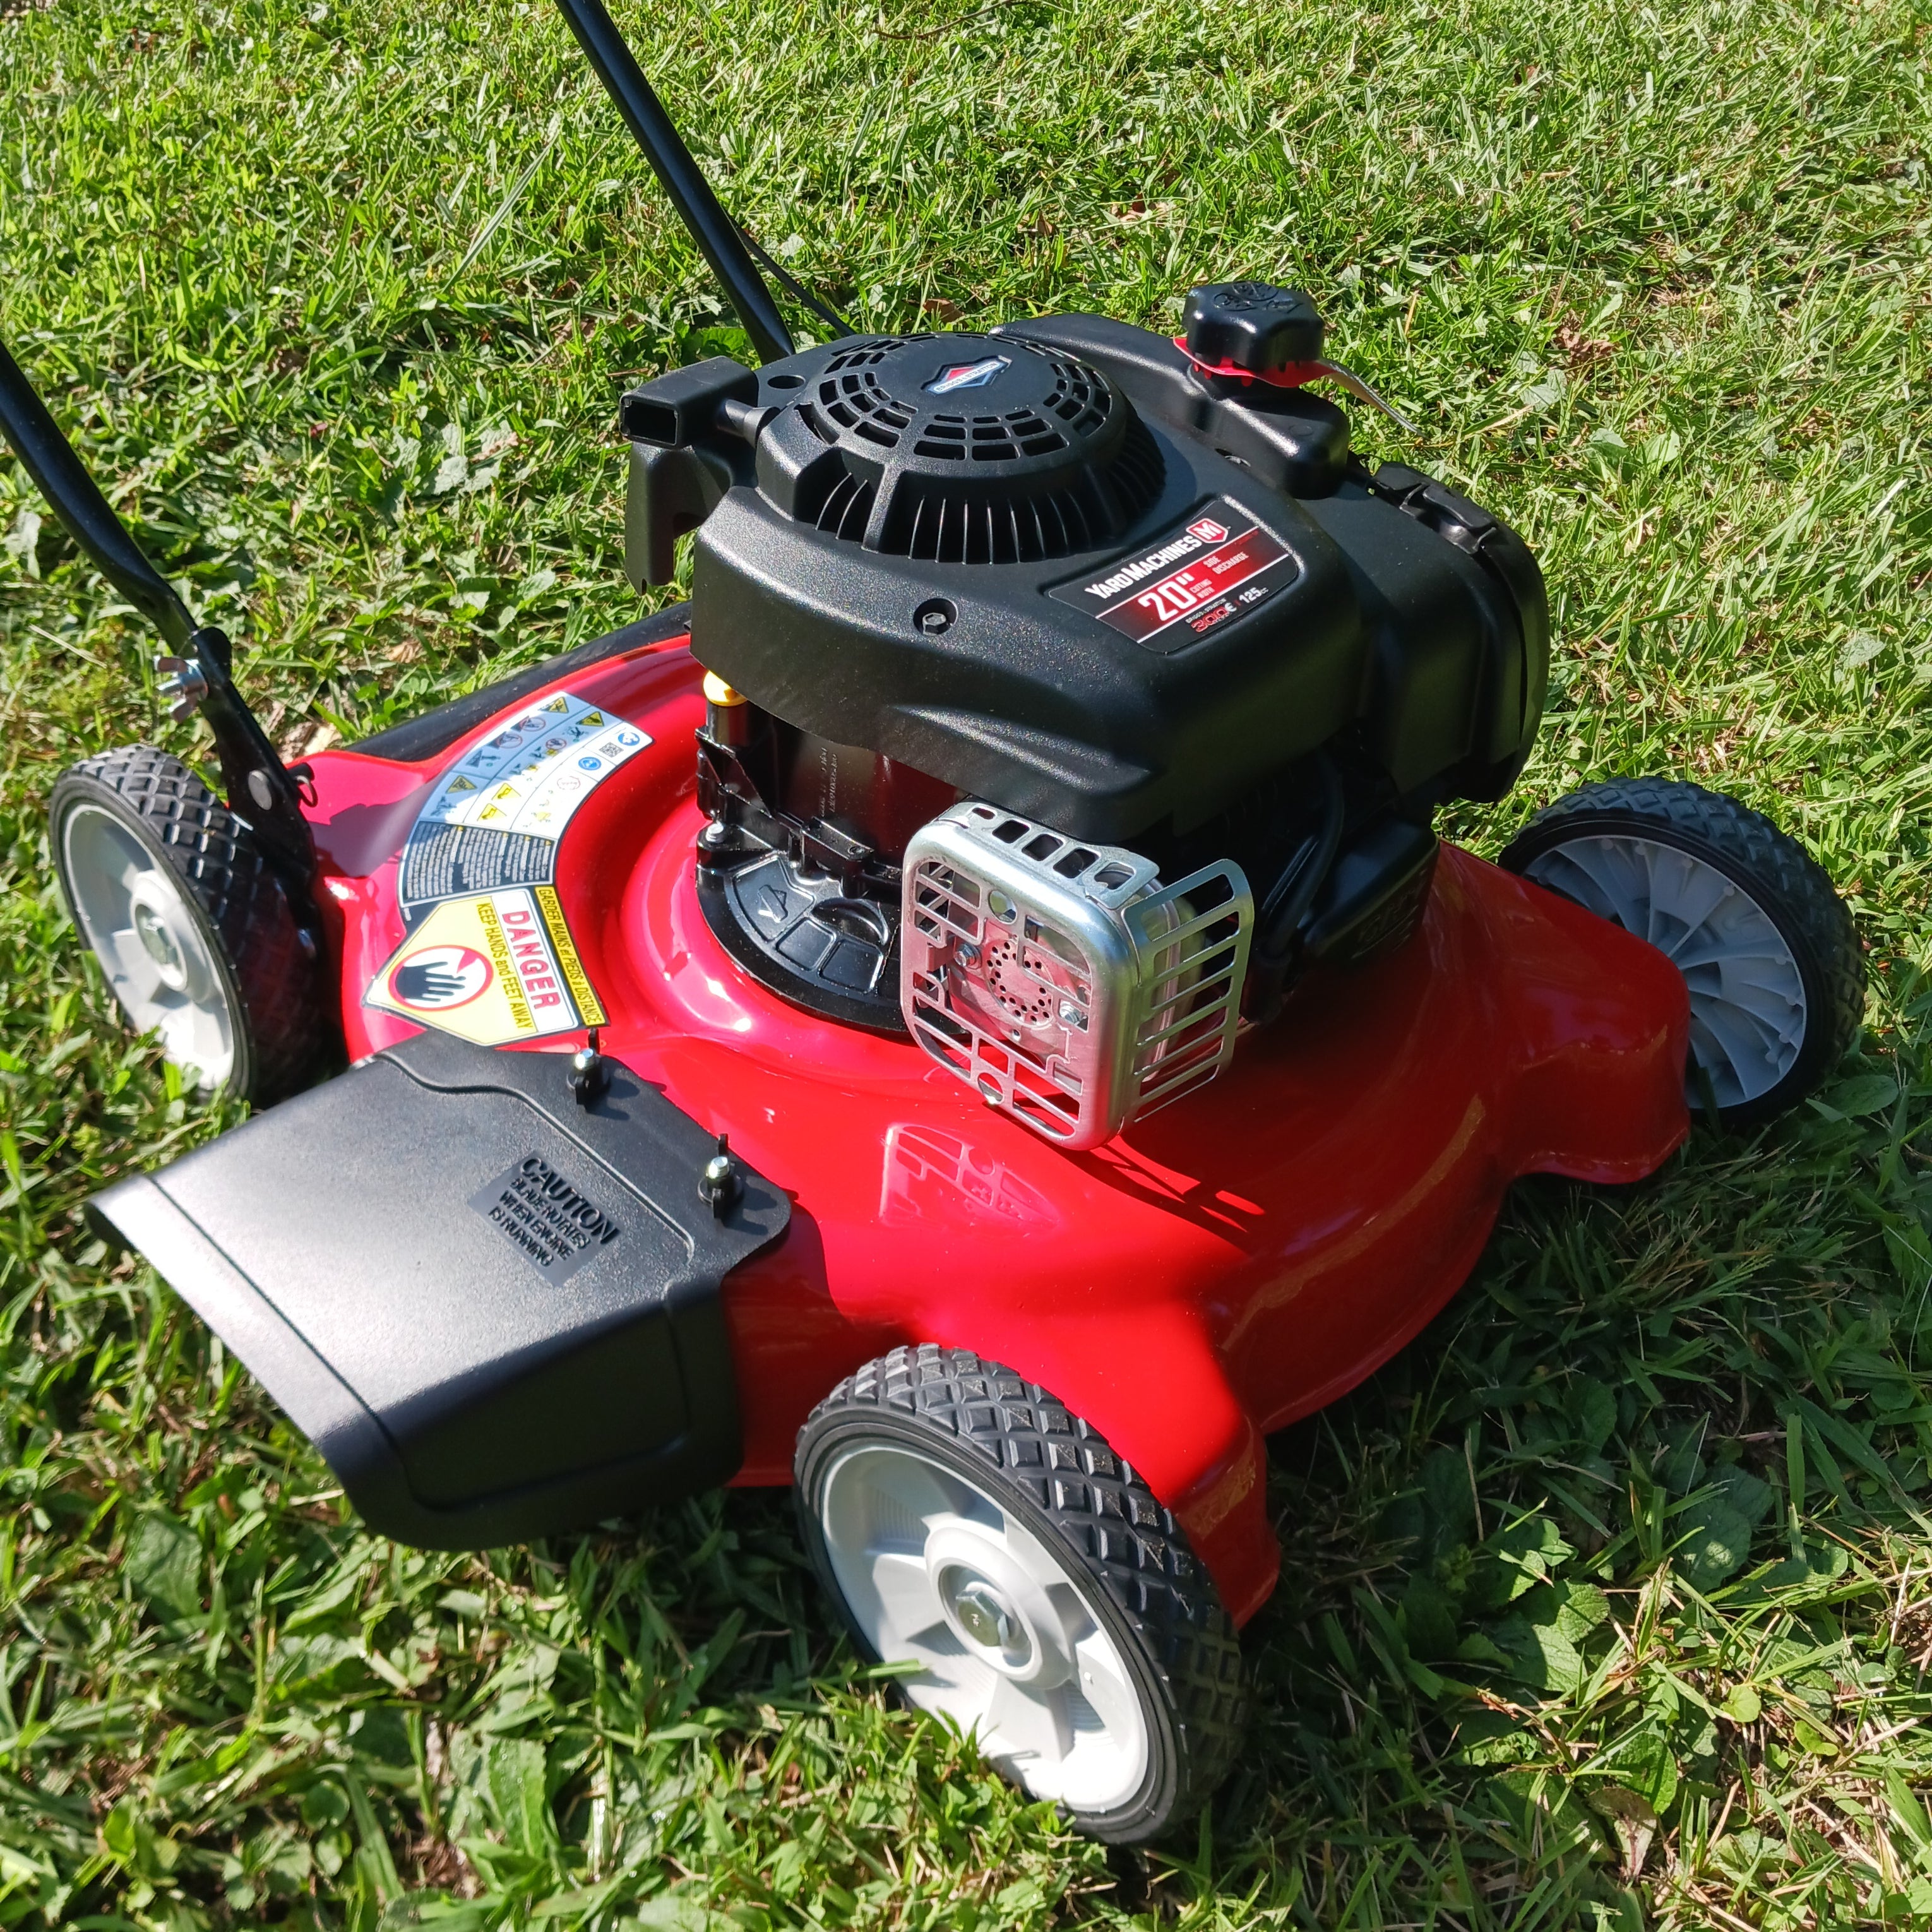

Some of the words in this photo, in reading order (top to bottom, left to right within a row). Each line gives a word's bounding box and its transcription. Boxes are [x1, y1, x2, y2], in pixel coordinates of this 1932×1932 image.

[936, 378, 963, 391] BRIGGS
[966, 362, 998, 378] STRATTON
[1203, 556, 1221, 568] SIDE
[1212, 551, 1249, 575] DISCHARGE
[477, 903, 498, 926] KEEP
[485, 927, 508, 958] HANDS
[539, 889, 561, 921] GARDER
[551, 922, 571, 950] MAINS
[563, 957, 583, 980] PIEDS
[575, 987, 602, 1023] DISTANCE
[496, 959, 515, 977] and
[502, 910, 561, 1010] DANGER
[502, 976, 523, 999] FEET
[510, 1002, 534, 1029] AWAY
[510, 1178, 547, 1212] BLADE
[520, 1157, 621, 1245] CAUTION
[499, 1190, 534, 1224] WHEN
[529, 1220, 575, 1261] ENGINE
[500, 1217, 554, 1267] RUNNING
